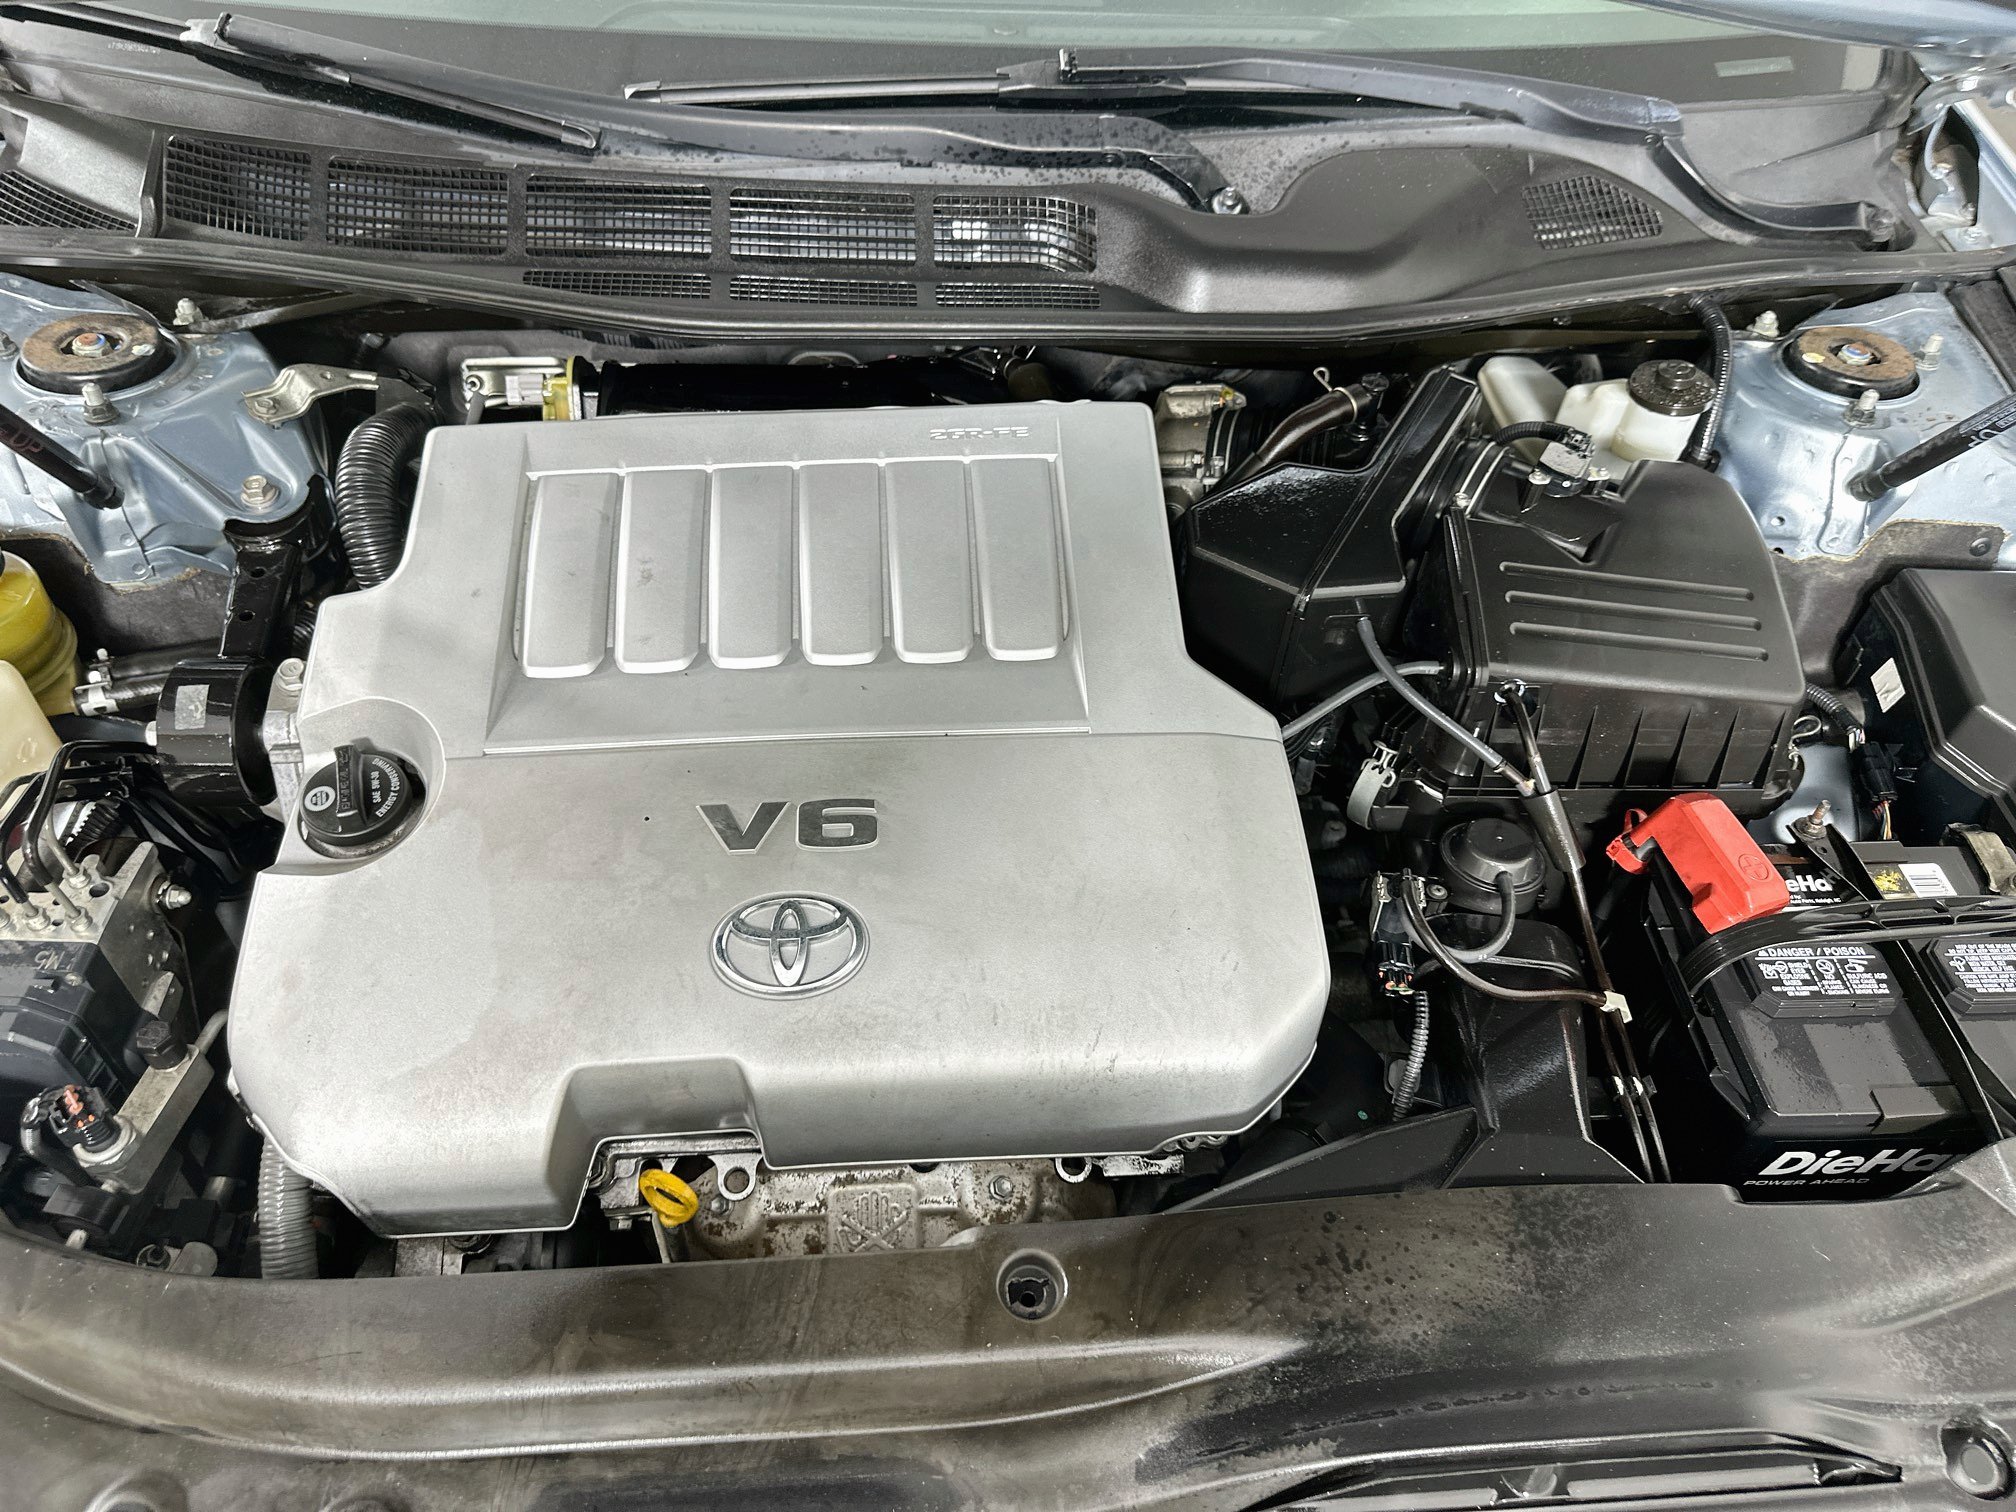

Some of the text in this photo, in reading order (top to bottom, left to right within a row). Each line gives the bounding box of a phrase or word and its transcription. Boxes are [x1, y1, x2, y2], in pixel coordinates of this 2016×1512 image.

[371, 757, 401, 818] ENERGY CONSERVING
[371, 790, 382, 804] SAE
[696, 798, 878, 855] V6
[1768, 946, 1866, 957] DANGER / POISON
